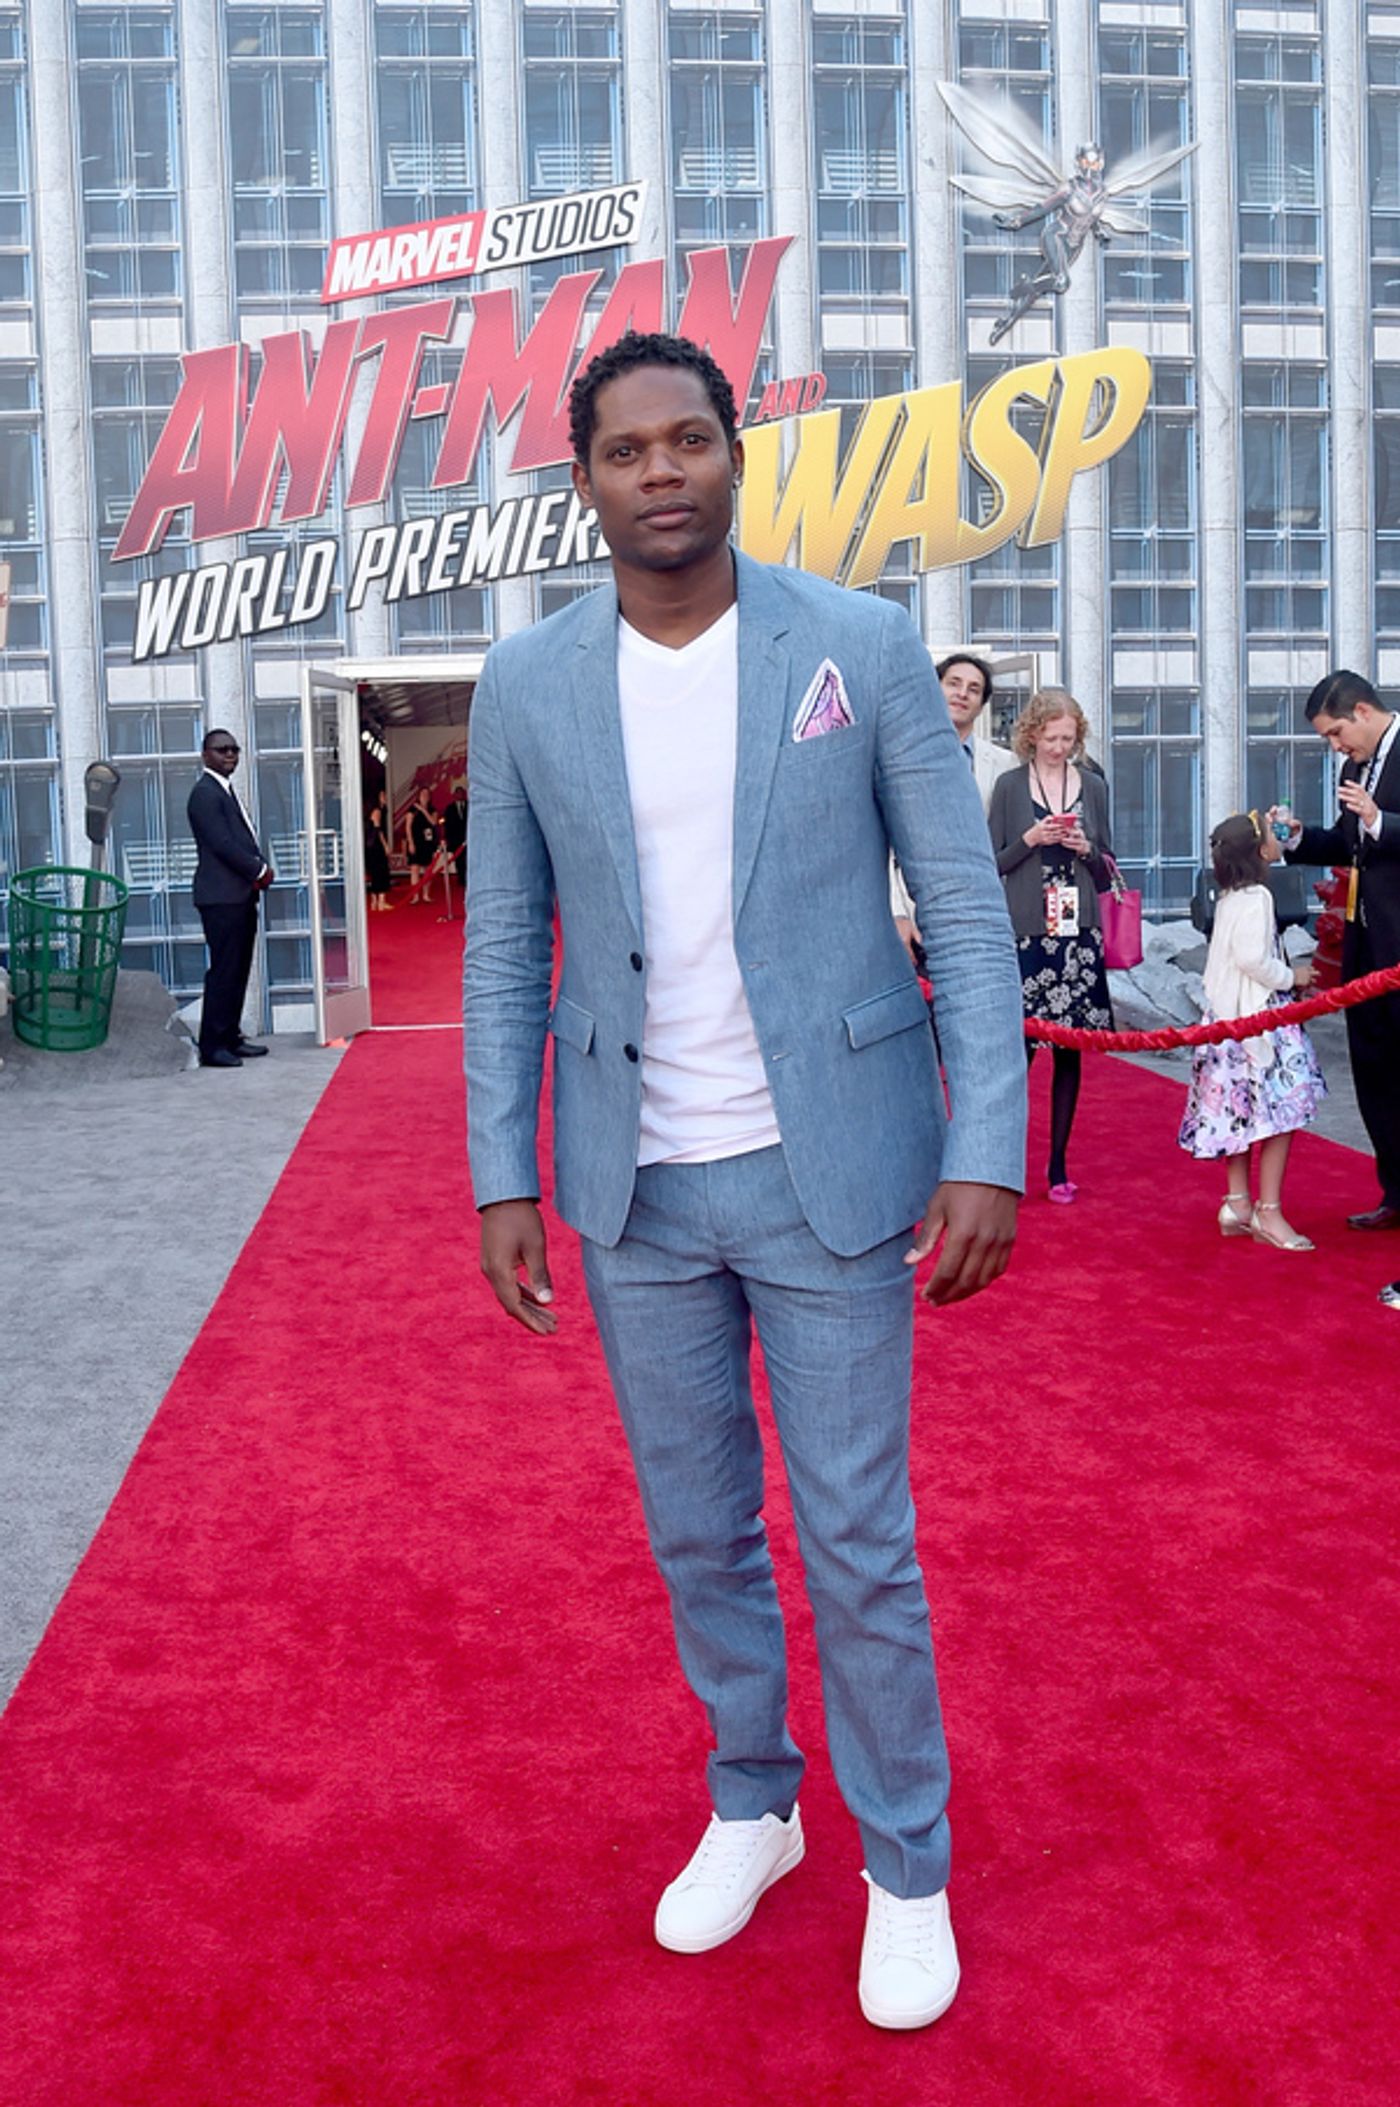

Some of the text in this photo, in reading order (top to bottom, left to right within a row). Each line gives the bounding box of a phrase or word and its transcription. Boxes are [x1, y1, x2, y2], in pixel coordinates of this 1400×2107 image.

[329, 189, 638, 295] MARVEL STUDIOS
[752, 371, 827, 423] AND
[740, 346, 1152, 590] WASP
[133, 489, 612, 662] WORLD PREMIER
